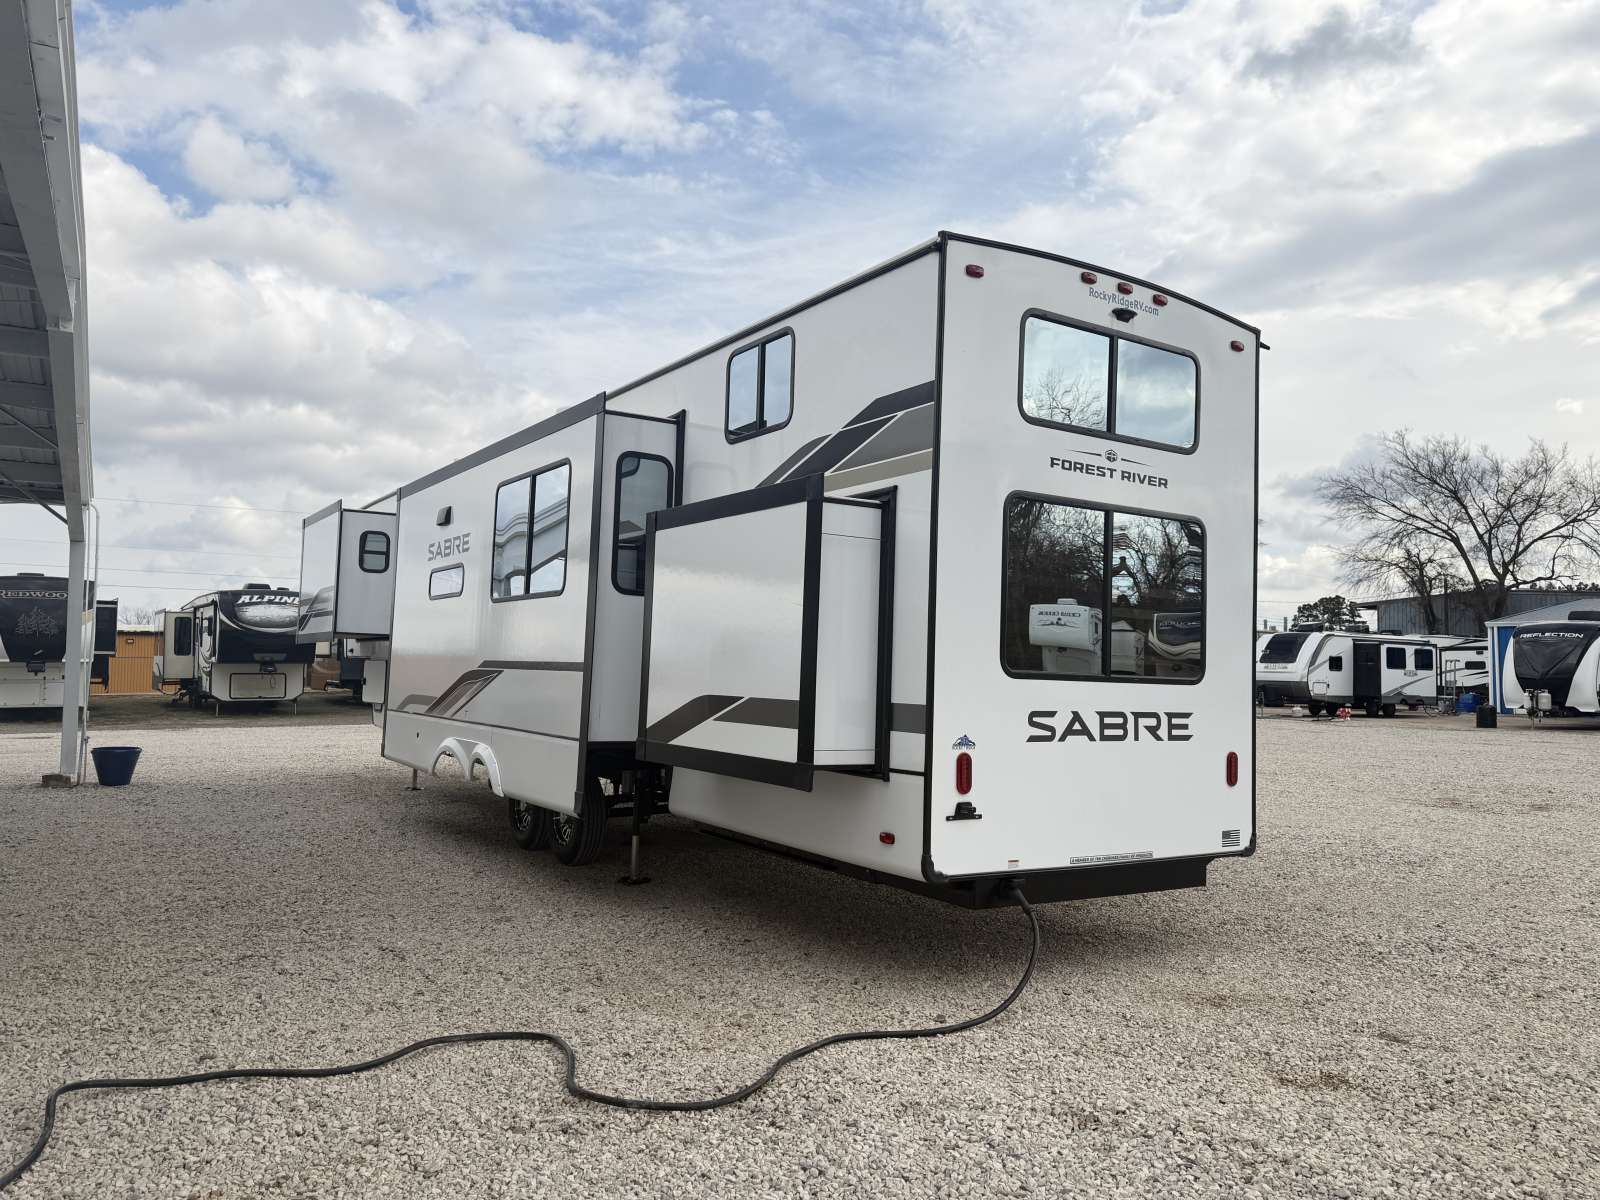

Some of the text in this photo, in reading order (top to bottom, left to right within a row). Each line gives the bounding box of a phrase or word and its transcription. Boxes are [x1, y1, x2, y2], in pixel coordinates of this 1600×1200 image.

[1089, 287, 1159, 316] RockyRidgeRV.com
[1050, 456, 1168, 488] FOREST RIVER
[427, 532, 471, 561] SABRE
[0, 590, 68, 599] REDWOO
[1026, 710, 1194, 742] SABRE
